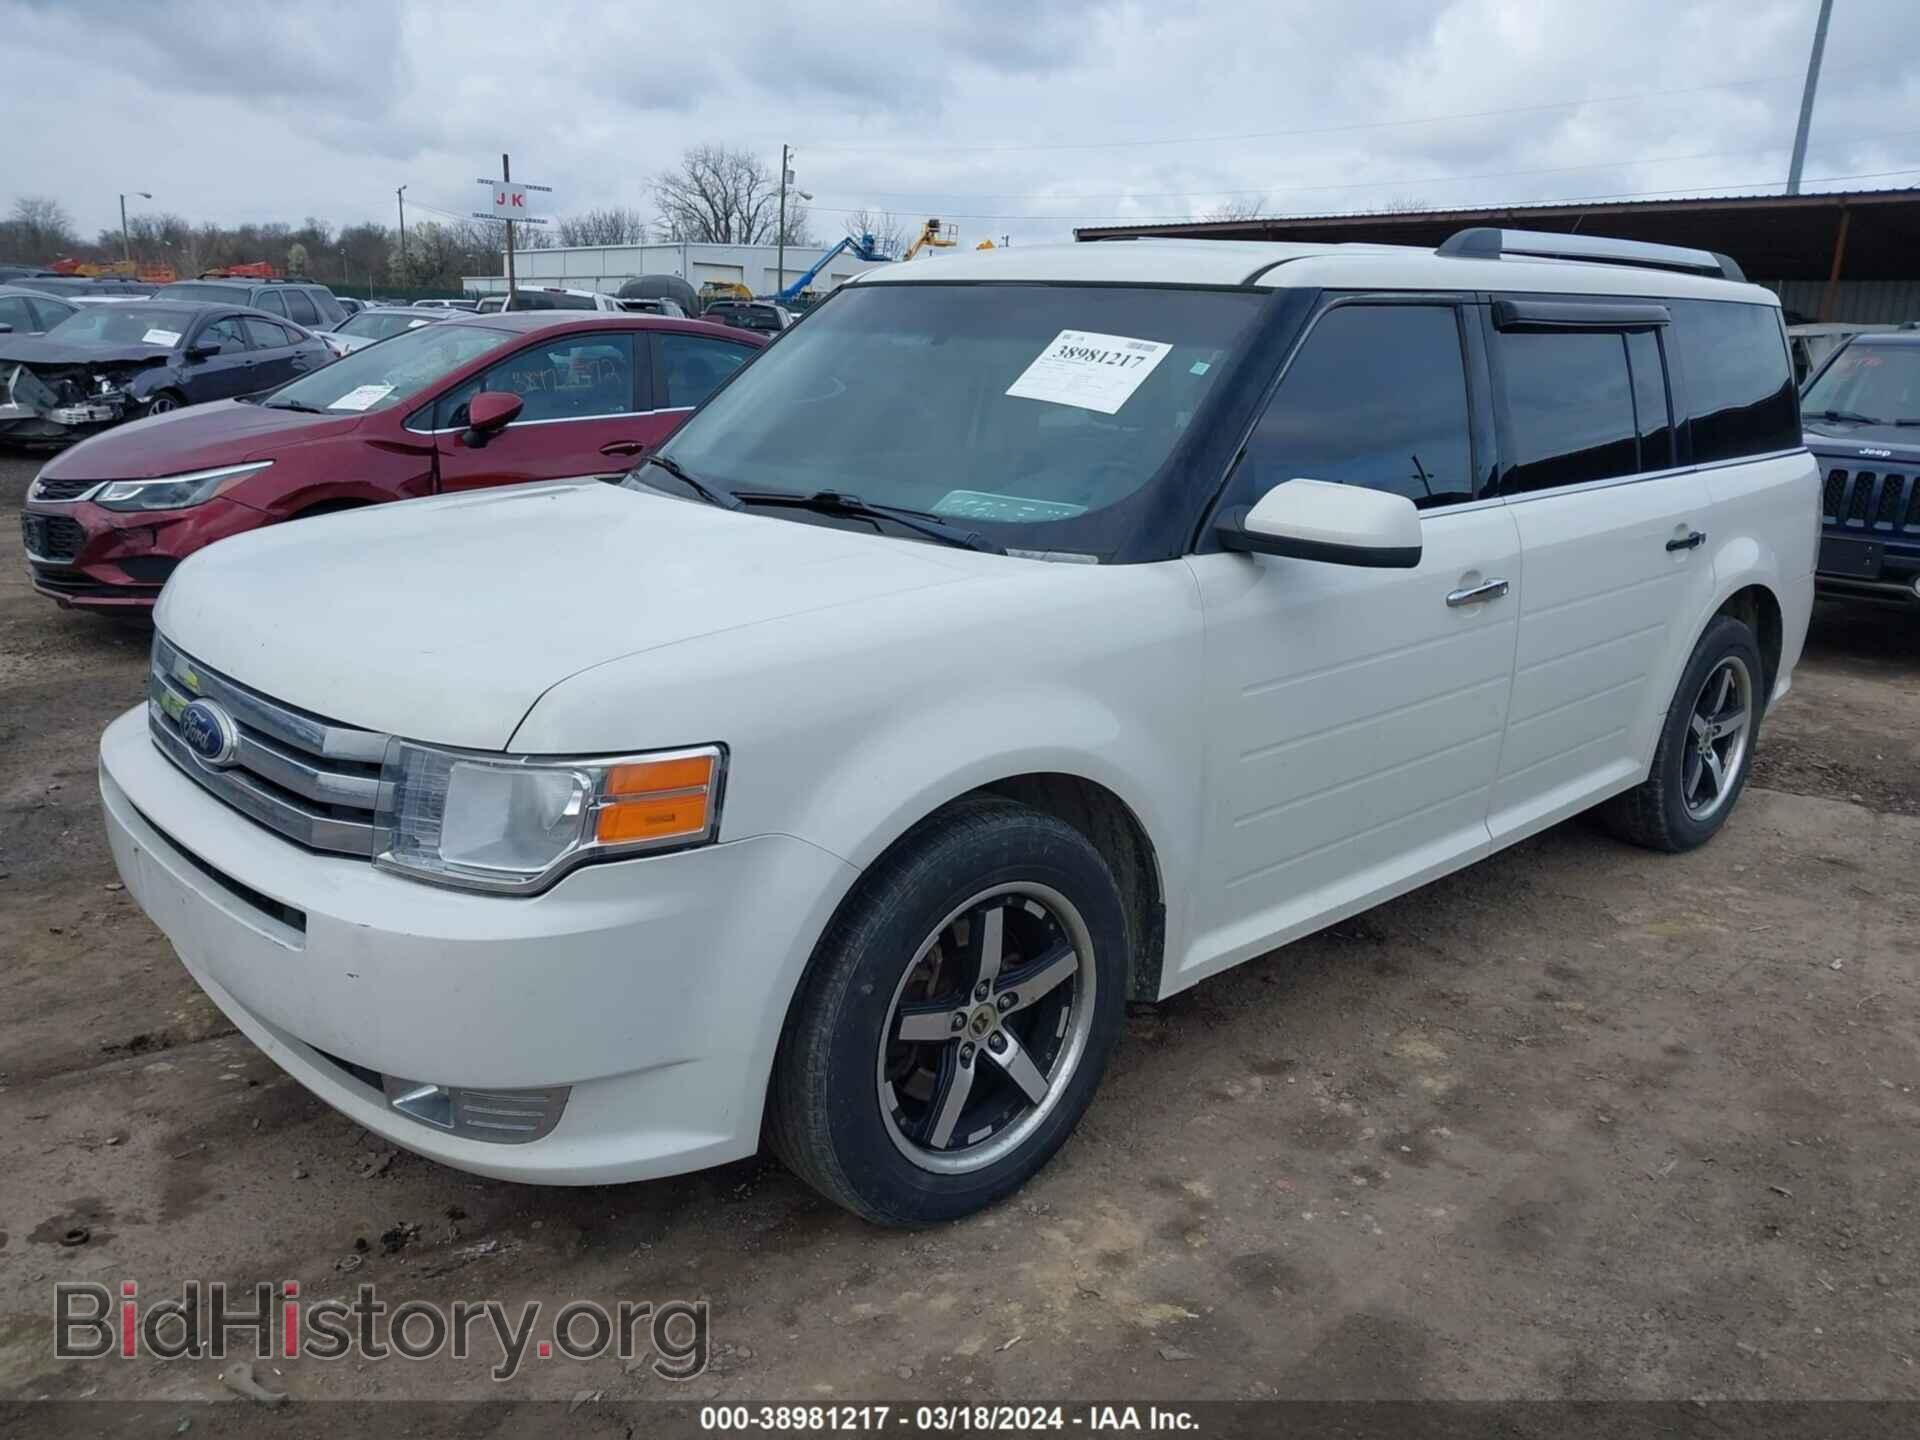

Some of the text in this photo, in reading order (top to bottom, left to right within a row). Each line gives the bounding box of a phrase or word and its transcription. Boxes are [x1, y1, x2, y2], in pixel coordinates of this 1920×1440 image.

[496, 192, 524, 207] J K
[1052, 345, 1147, 369] 38981217
[1859, 448, 1891, 457] Jeep
[183, 708, 212, 748] Ford
